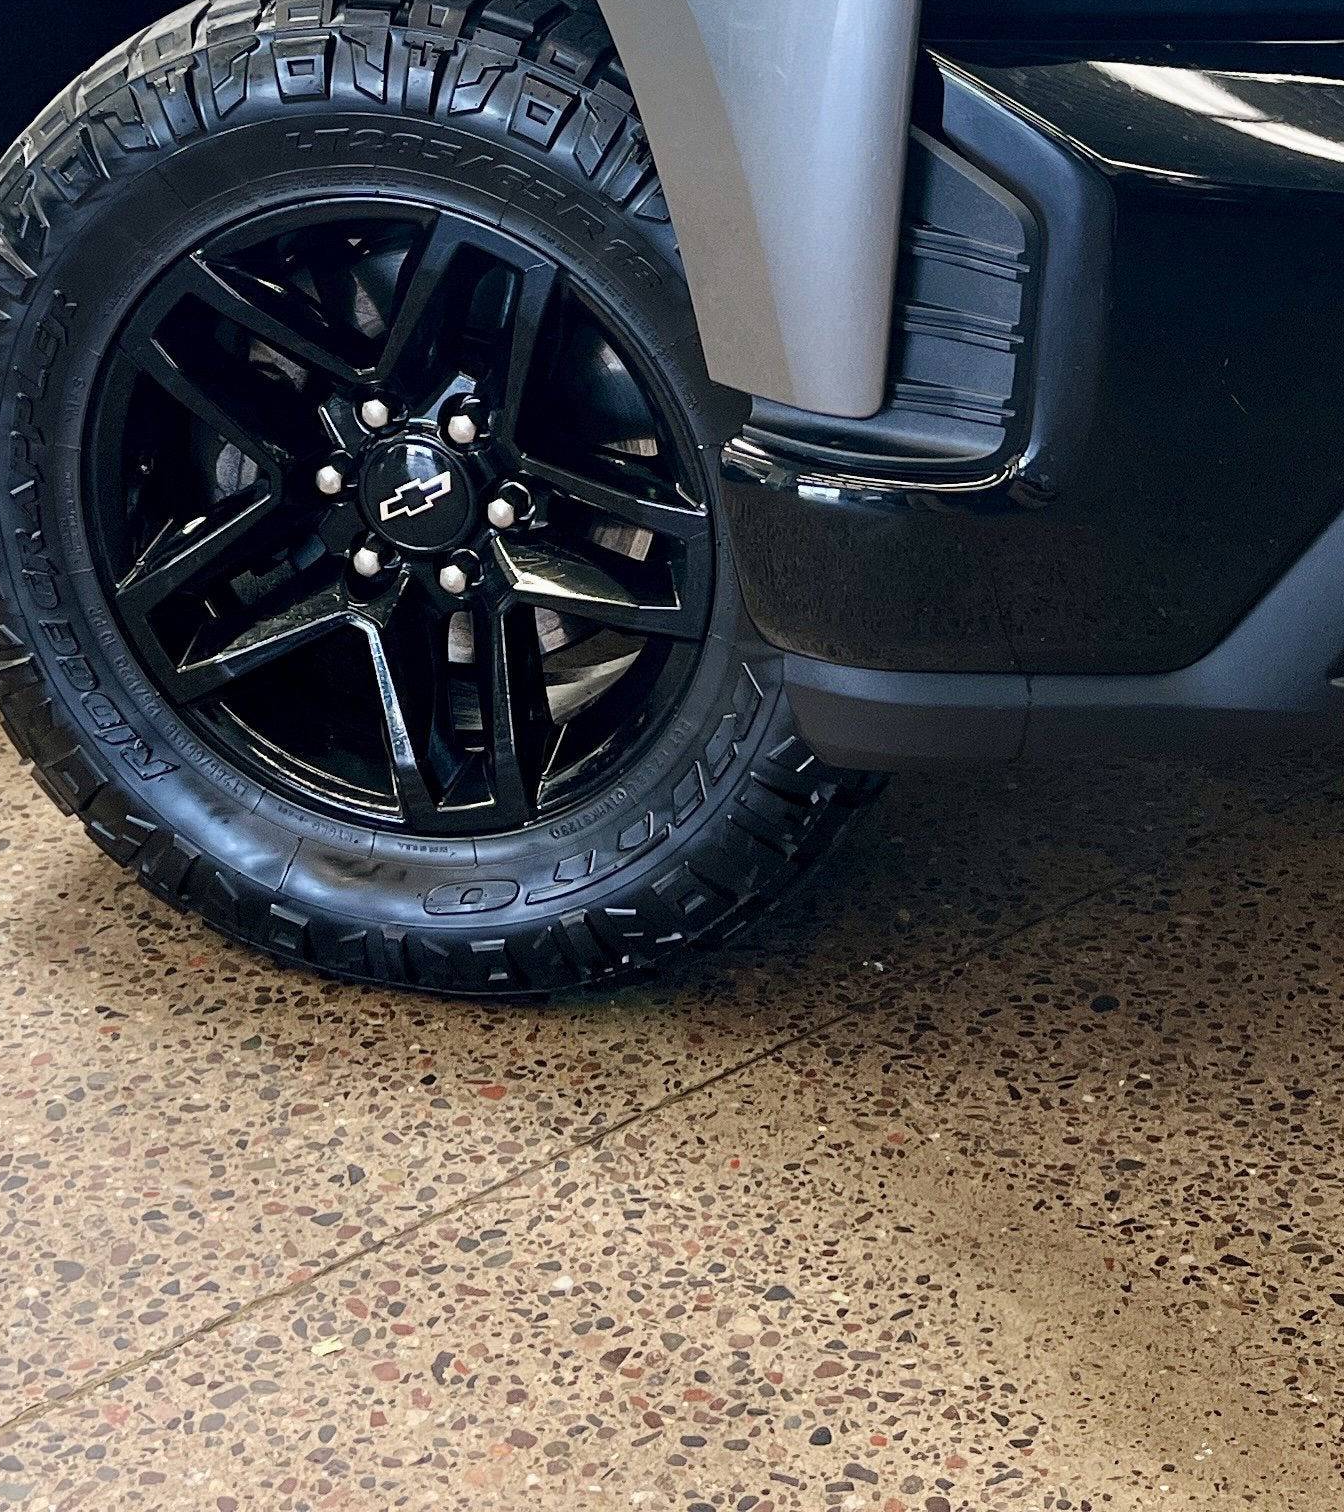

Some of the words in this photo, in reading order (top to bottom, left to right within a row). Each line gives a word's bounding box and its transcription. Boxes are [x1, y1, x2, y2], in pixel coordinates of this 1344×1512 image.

[9, 289, 77, 610] GRAPPLER
[37, 618, 181, 781] RIDGE
[423, 661, 766, 916] NITTO
